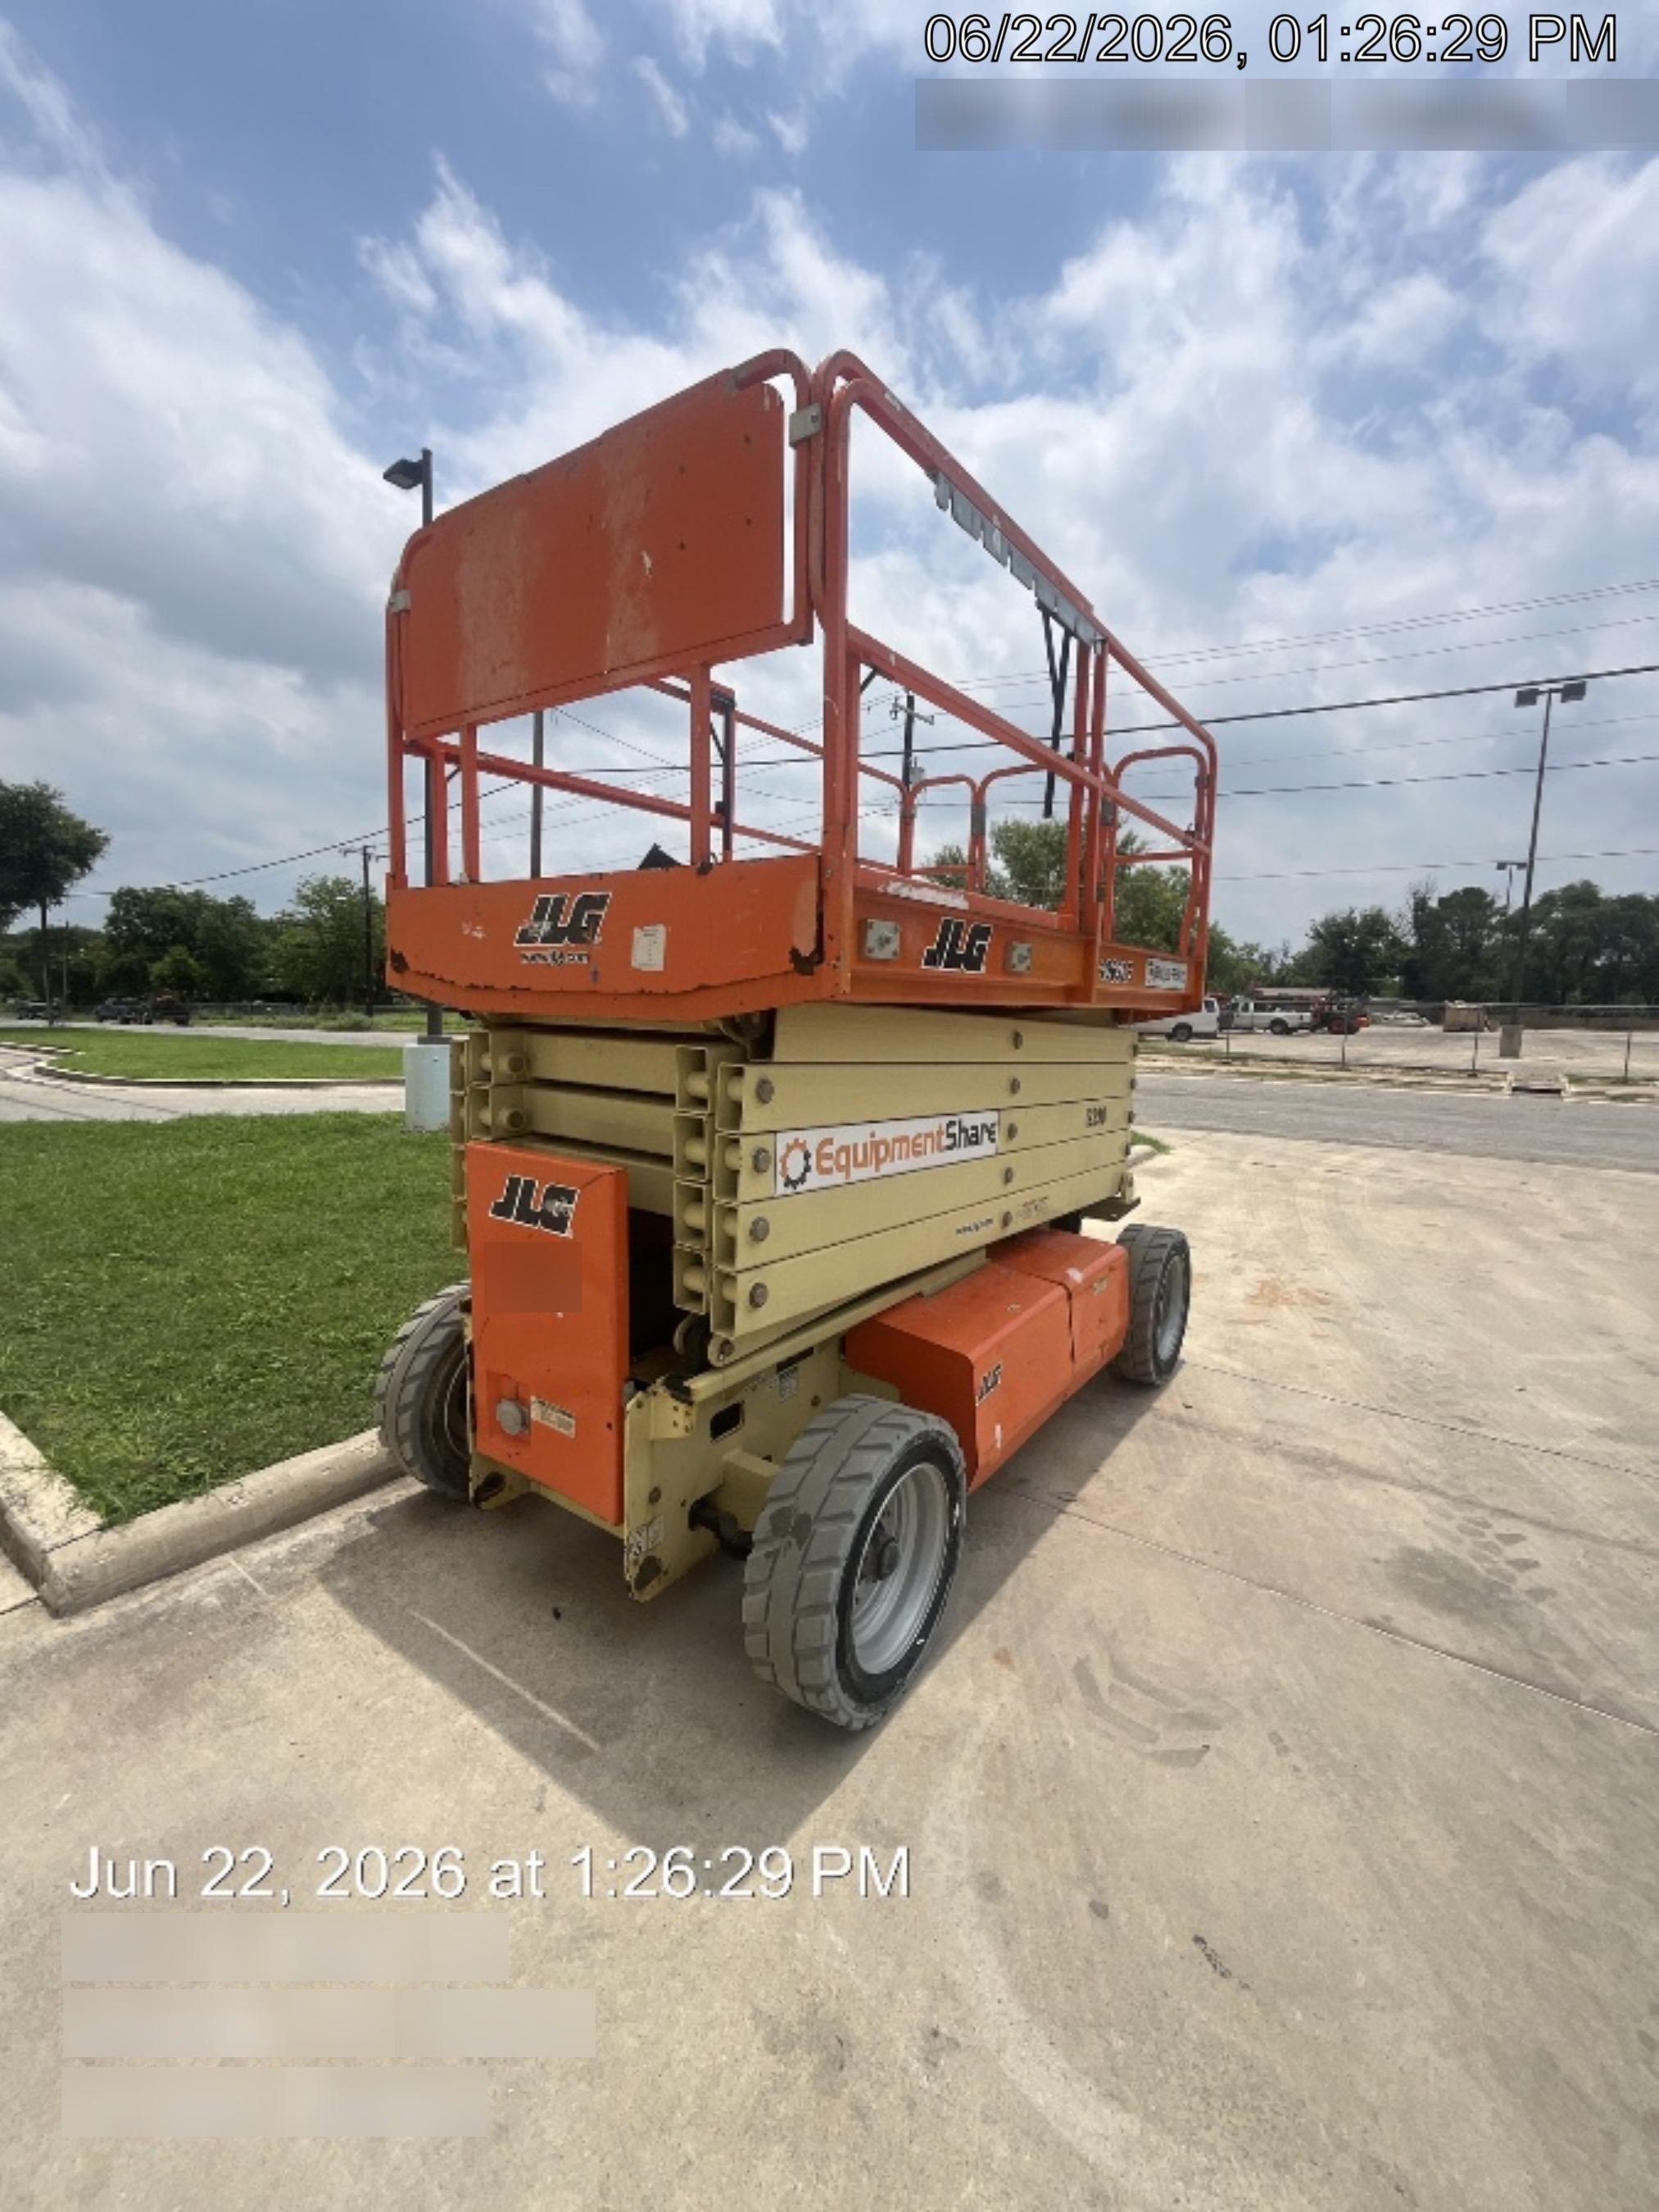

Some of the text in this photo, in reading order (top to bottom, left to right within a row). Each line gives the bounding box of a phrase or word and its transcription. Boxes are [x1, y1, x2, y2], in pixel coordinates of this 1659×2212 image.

[514, 891, 612, 946] JLG
[921, 918, 993, 973] JLG
[815, 1119, 997, 1180] EquipmentShare
[489, 1174, 580, 1239] JLG
